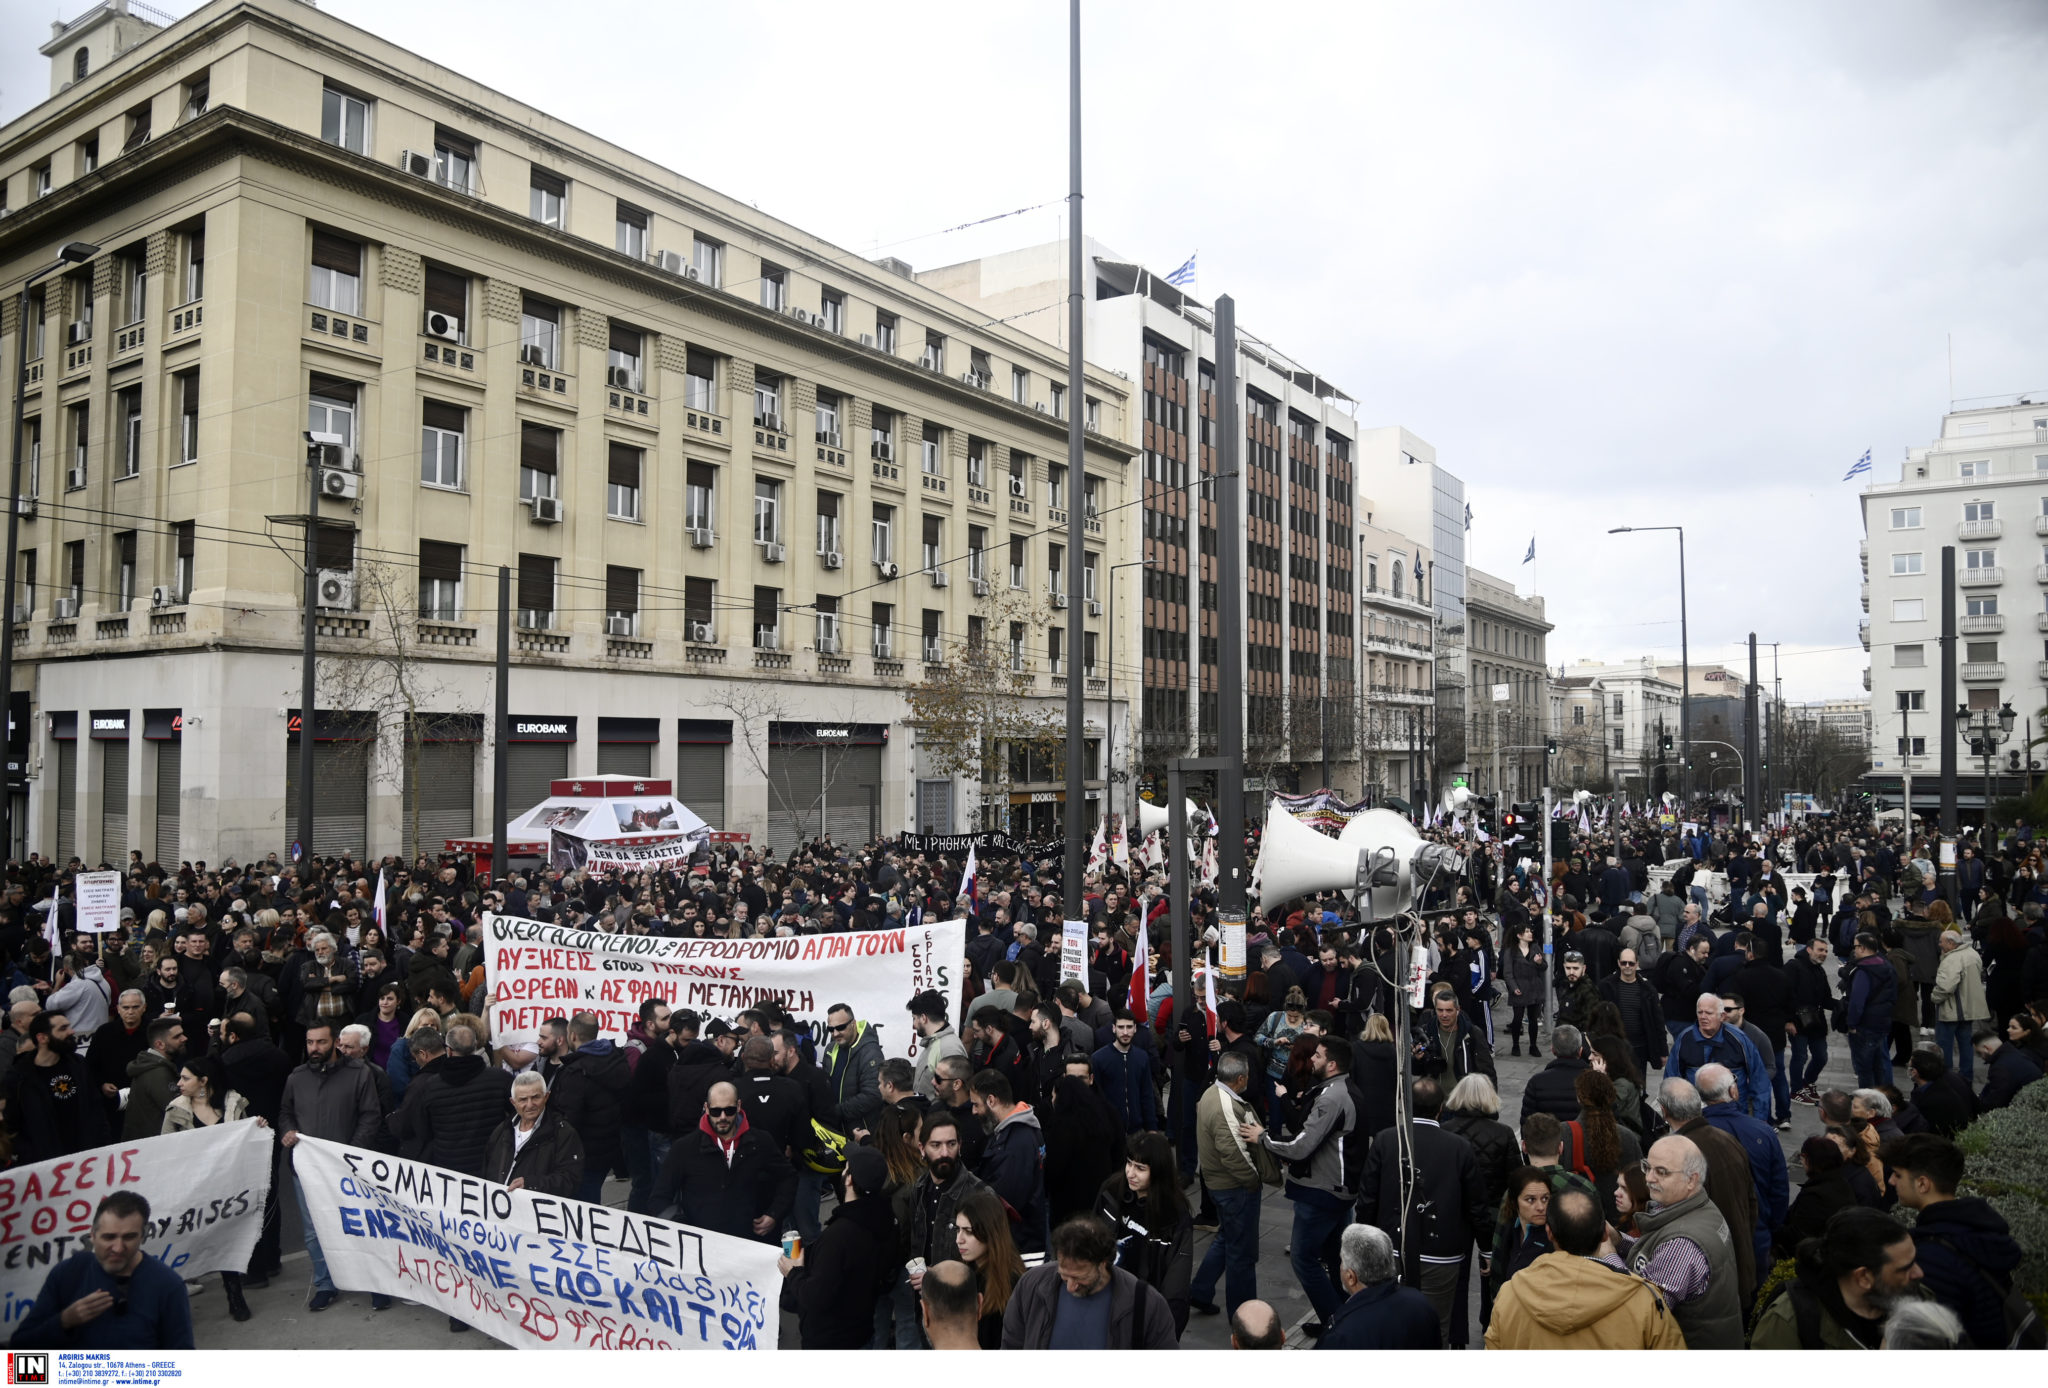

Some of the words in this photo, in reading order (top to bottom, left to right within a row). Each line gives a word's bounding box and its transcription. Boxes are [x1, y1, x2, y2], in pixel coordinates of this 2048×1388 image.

[93, 719, 125, 730] EUROBANK
[517, 723, 567, 733] EUROBANK
[816, 729, 849, 737] EUROBANK
[1031, 793, 1052, 802] BOOKS
[594, 850, 613, 860] ΔΕΝ
[617, 851, 630, 860] ΘΑ
[634, 846, 684, 860] ΞΕΧΑΣΤΕΙ
[513, 921, 659, 955] ΕΡΓΑΖΟΜΕΝΟΙ
[673, 939, 799, 960] ΑΕΡΟΔΡΟΜΙΟ
[802, 930, 906, 960] ΑΠΑΙΤΟΥΝ
[497, 947, 597, 971] ΑΥΞΗΣΕΙΣ
[651, 961, 745, 981] ΜΙΣΘΟΥΣ
[496, 977, 579, 1002] ΔΩΡΕΑΝ
[601, 977, 677, 1004] ΑΣΦΑΛΗ
[688, 982, 814, 1012] ΜΕΤΑΚΙΝΗΣΗ
[0, 1199, 93, 1245] ΣΘΩ
[177, 1189, 250, 1236] RISES
[343, 1153, 512, 1221] ΣΩΜΑΤΕΙΟ
[531, 1198, 708, 1277] ΕΝΕΔΕΠ
[548, 1238, 613, 1276] ΣΣΕ
[508, 1292, 559, 1342] 28
[529, 1263, 612, 1309] ΕΔΩ
[613, 1277, 684, 1337] ΚΑΙ
